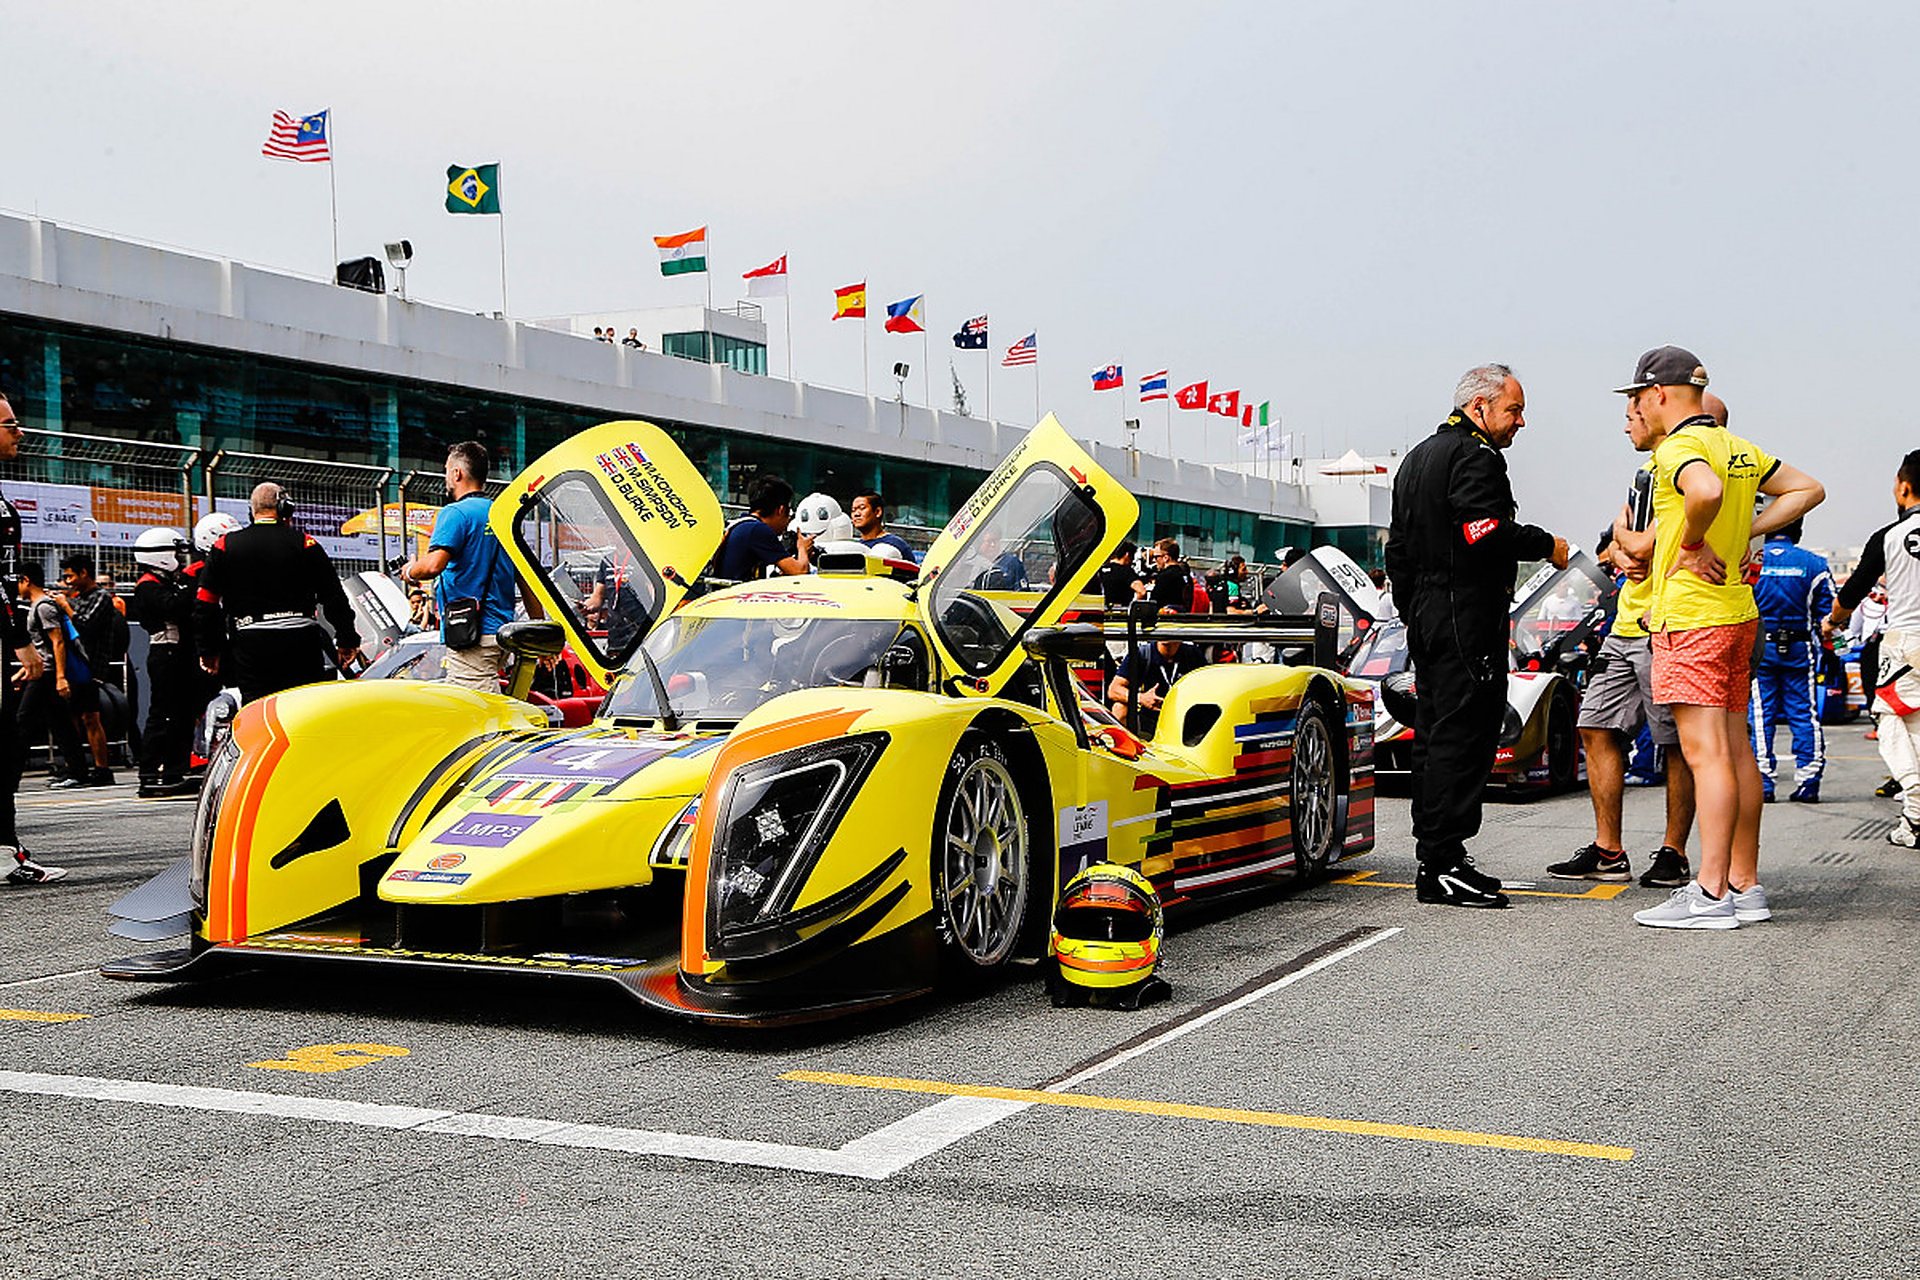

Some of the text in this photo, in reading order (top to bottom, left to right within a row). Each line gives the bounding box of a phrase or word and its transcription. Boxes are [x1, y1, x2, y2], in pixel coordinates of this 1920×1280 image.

[611, 473, 654, 522] D.BURKE
[626, 466, 680, 529] M.SIMPSON
[971, 465, 1018, 518] D.BURKE
[1849, 676, 1863, 693] 2
[551, 748, 615, 772] 4
[449, 821, 523, 839] LMP3
